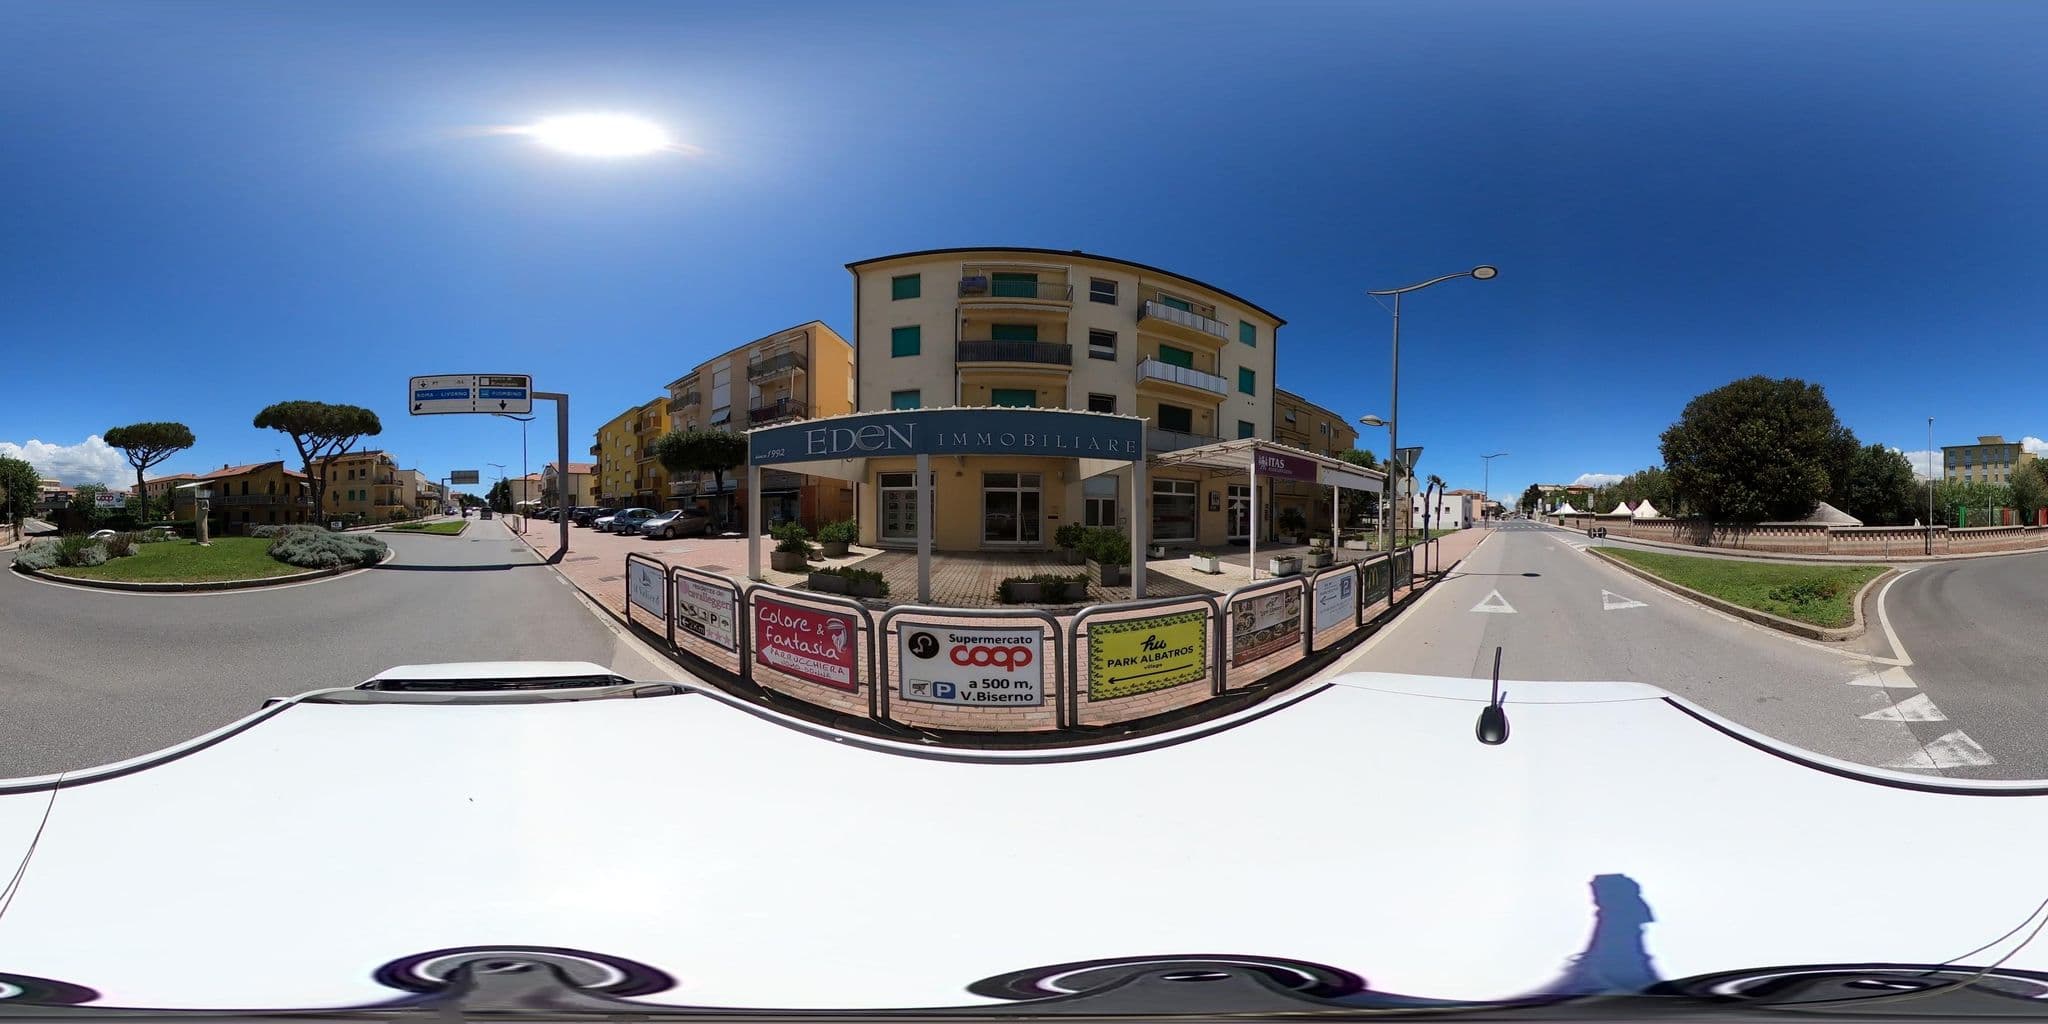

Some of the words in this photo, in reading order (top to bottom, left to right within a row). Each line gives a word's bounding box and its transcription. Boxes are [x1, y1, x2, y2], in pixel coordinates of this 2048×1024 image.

[938, 433, 1137, 453] IMMOBILIARE
[767, 448, 785, 458] 1992
[1268, 456, 1286, 470] ITAS
[760, 607, 811, 632] Colore
[816, 624, 825, 636] &
[949, 633, 1033, 645] Supermercato
[770, 648, 845, 675] PARRUCCHIERA
[949, 645, 1033, 672] coop
[1107, 657, 1138, 668] PARK
[1140, 645, 1194, 664] ALBATROS
[936, 684, 949, 697] P
[969, 680, 978, 689] a
[983, 679, 1010, 689] 500
[1014, 680, 1033, 690] m,
[961, 691, 1034, 702] V.Biserno
